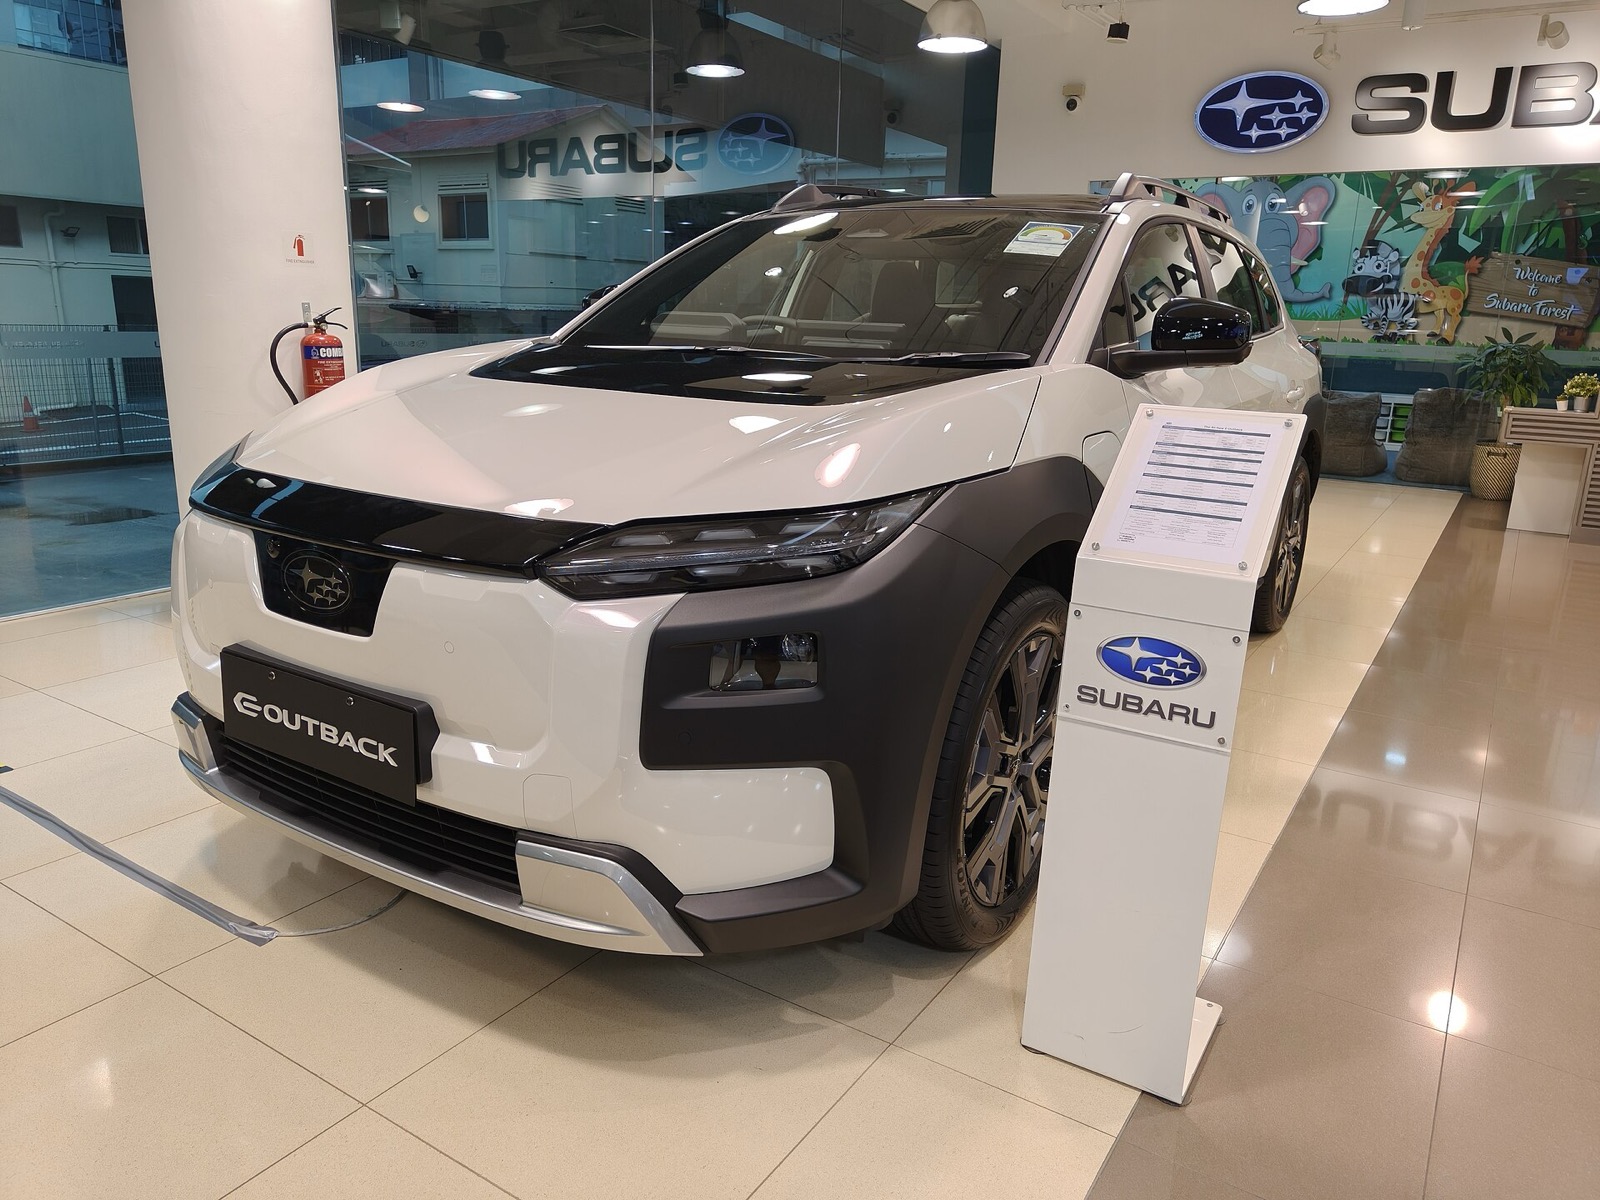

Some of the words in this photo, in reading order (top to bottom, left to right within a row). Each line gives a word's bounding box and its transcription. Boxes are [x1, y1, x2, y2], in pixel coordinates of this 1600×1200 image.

[1351, 61, 1600, 135] SUB
[1513, 266, 1562, 284] Welcome
[1527, 283, 1539, 297] to
[1483, 293, 1532, 314] Subaru
[1533, 299, 1580, 320] Forest
[1076, 684, 1216, 729] SUBARU
